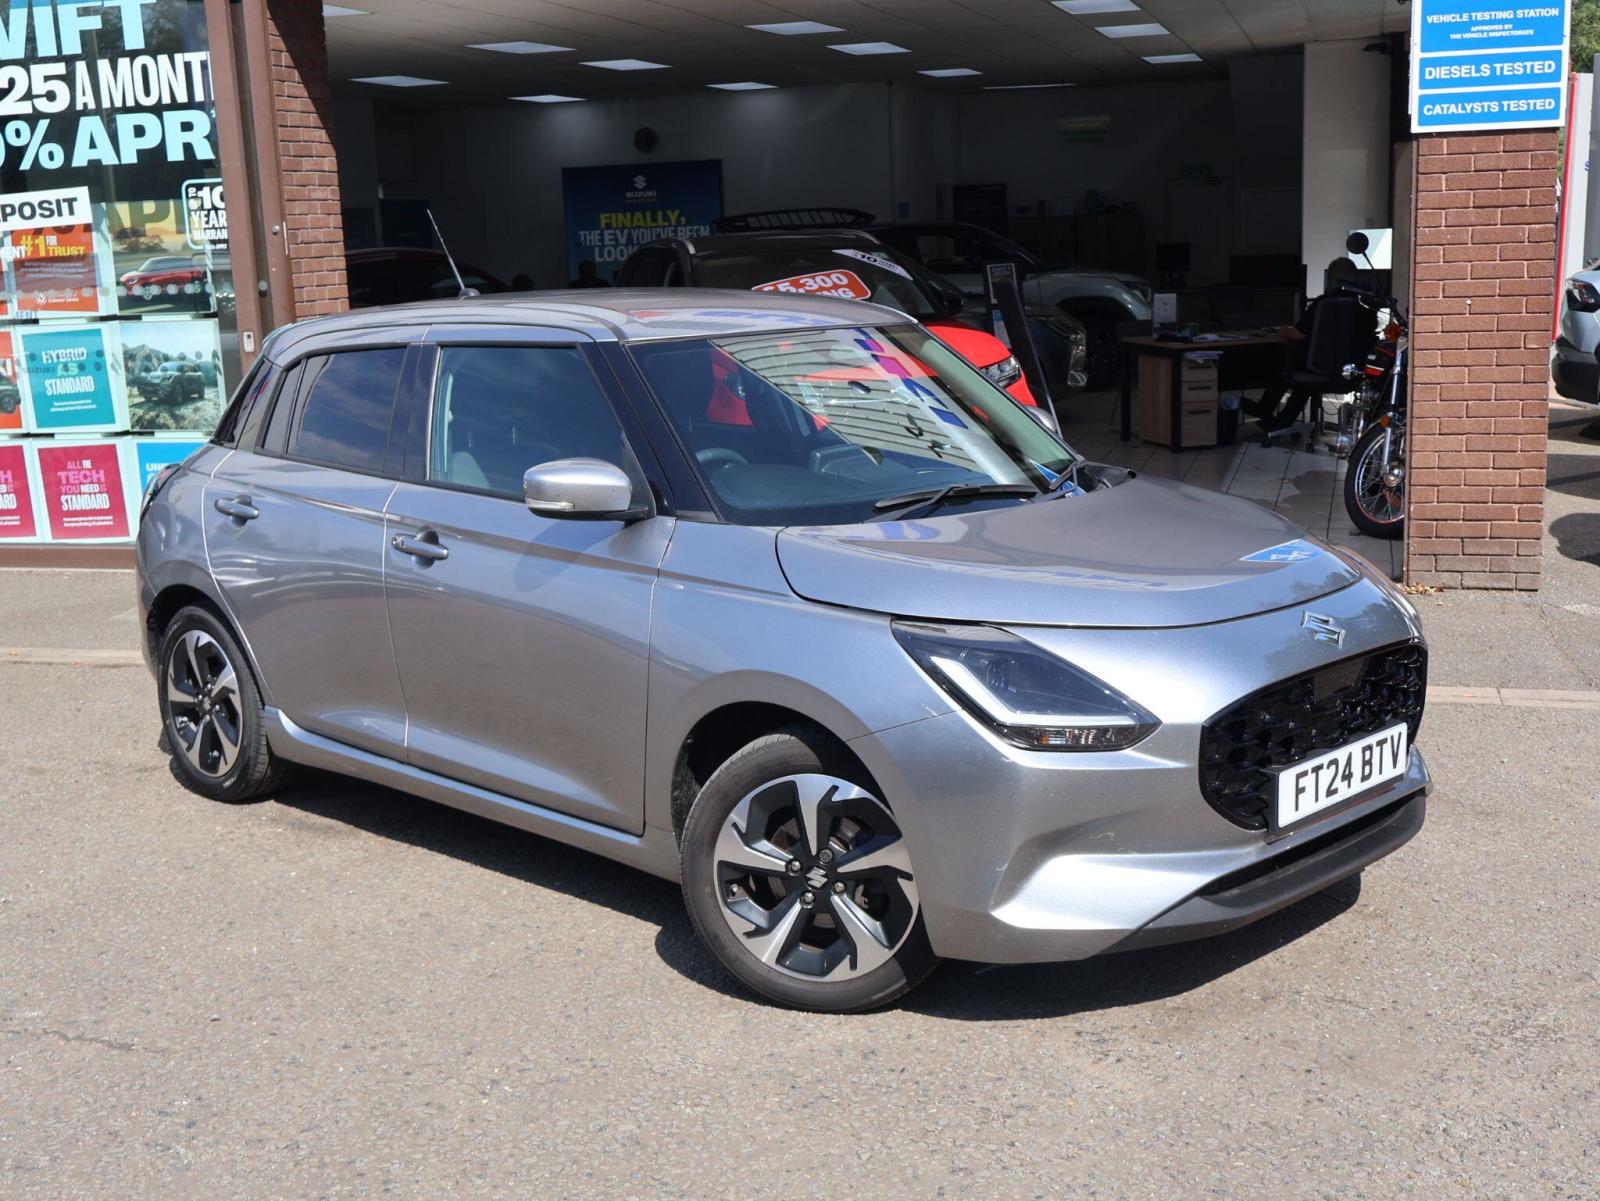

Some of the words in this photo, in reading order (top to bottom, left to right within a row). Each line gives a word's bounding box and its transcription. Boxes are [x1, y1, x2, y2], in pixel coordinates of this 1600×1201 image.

[1426, 13, 1469, 24] VEHICLE
[1471, 10, 1514, 20] TESTING
[1516, 8, 1559, 17] STATION
[1424, 64, 1491, 80] DIESELS
[1493, 61, 1556, 76] TESTED
[75, 60, 96, 110] A
[97, 51, 214, 109] MONT
[1423, 100, 1499, 116] CATALYSTS
[1502, 98, 1556, 112] TESTED
[0, 197, 78, 222] POSIT
[600, 209, 687, 229] FINALLY,
[578, 230, 601, 247] THE
[604, 228, 628, 245] EV
[47, 246, 86, 257] TRUST
[42, 347, 87, 364] HYBRID
[57, 362, 79, 376] AS
[44, 375, 95, 396] STANDARD
[67, 461, 82, 469] ALL
[57, 469, 105, 484] TECH
[60, 485, 80, 494] YOU
[80, 484, 99, 493] NEED
[60, 493, 110, 511] STANDARD
[1295, 751, 1353, 812] FT24
[1361, 732, 1402, 784] BTV
